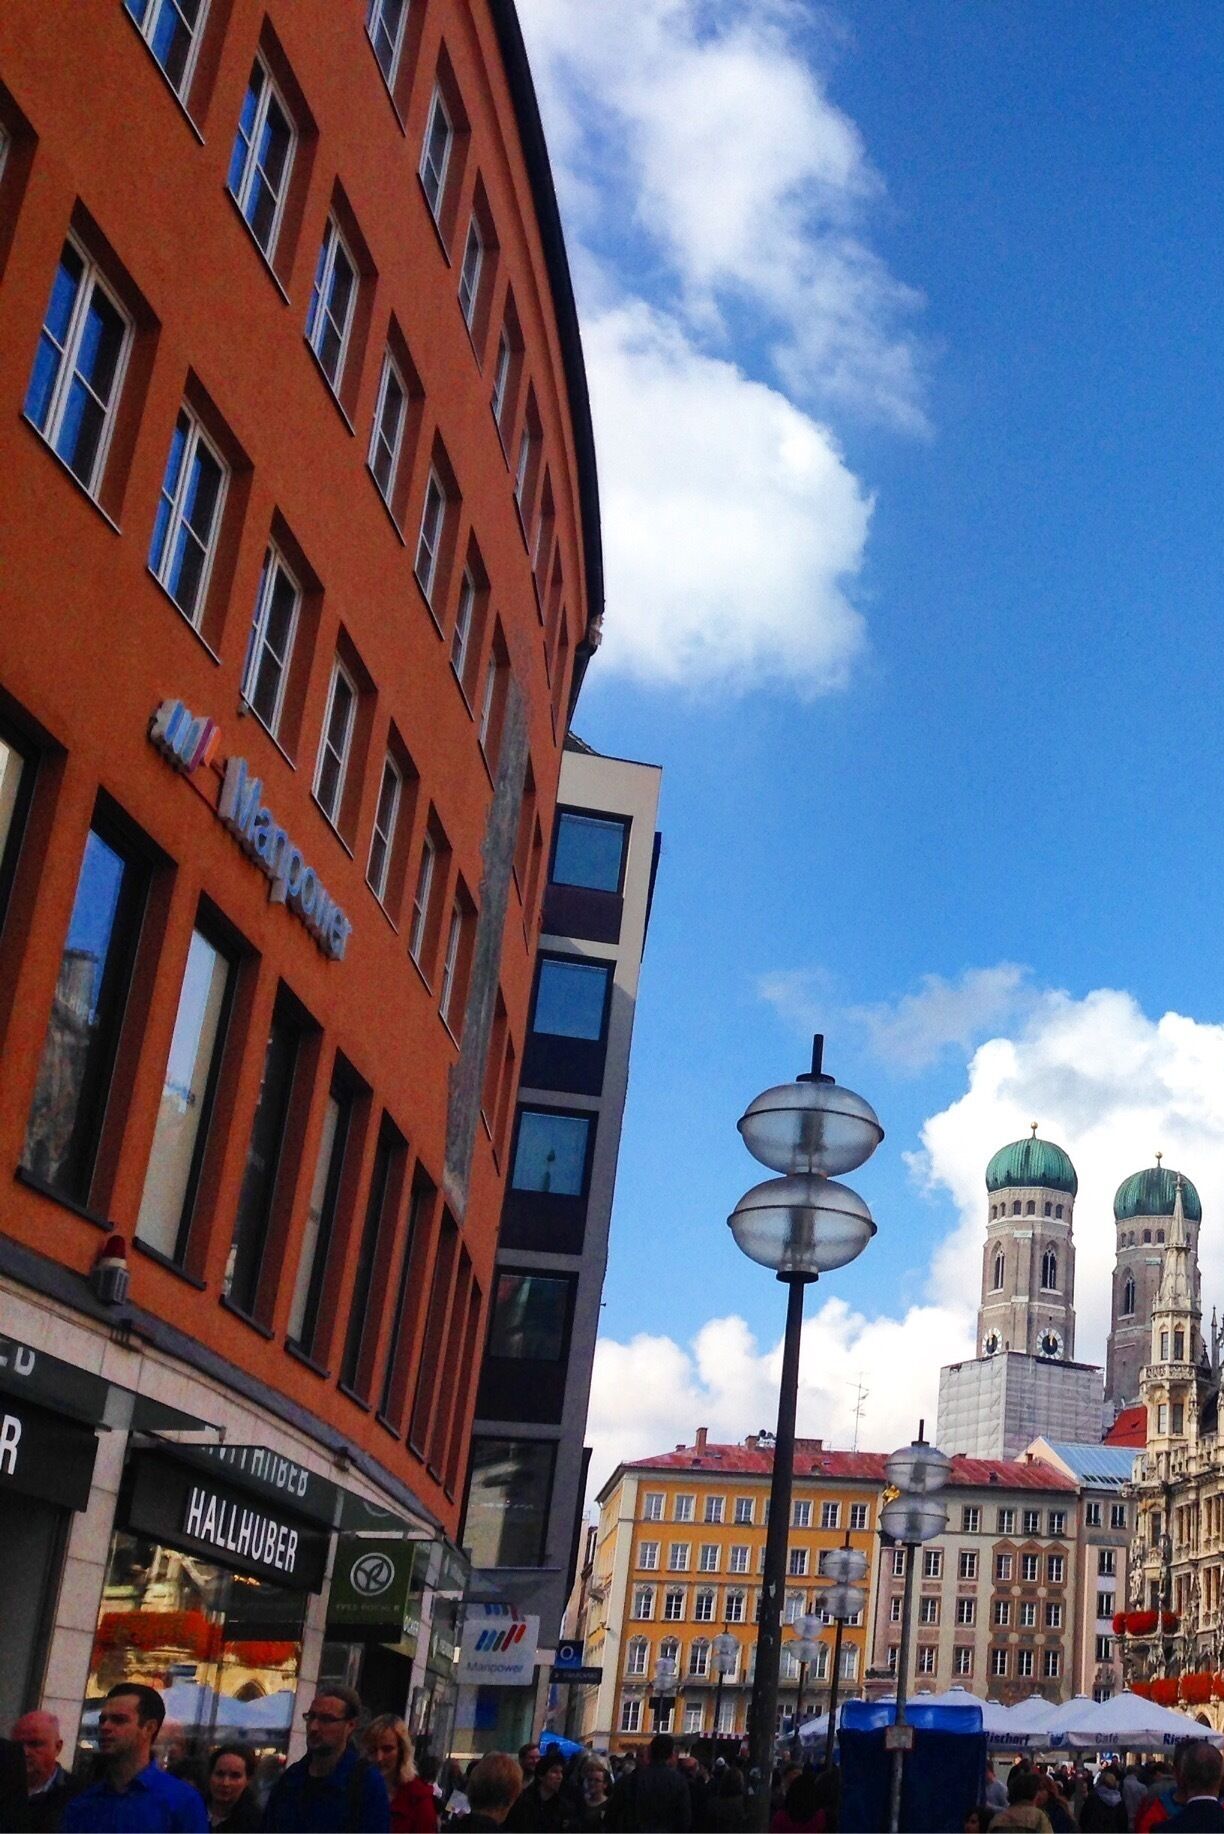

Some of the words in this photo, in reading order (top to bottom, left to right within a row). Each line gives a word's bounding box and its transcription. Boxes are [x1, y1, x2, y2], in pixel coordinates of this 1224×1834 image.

[217, 756, 352, 961] Manpower
[186, 1486, 299, 1573] HALLHUBER
[466, 1661, 524, 1675] Manpower
